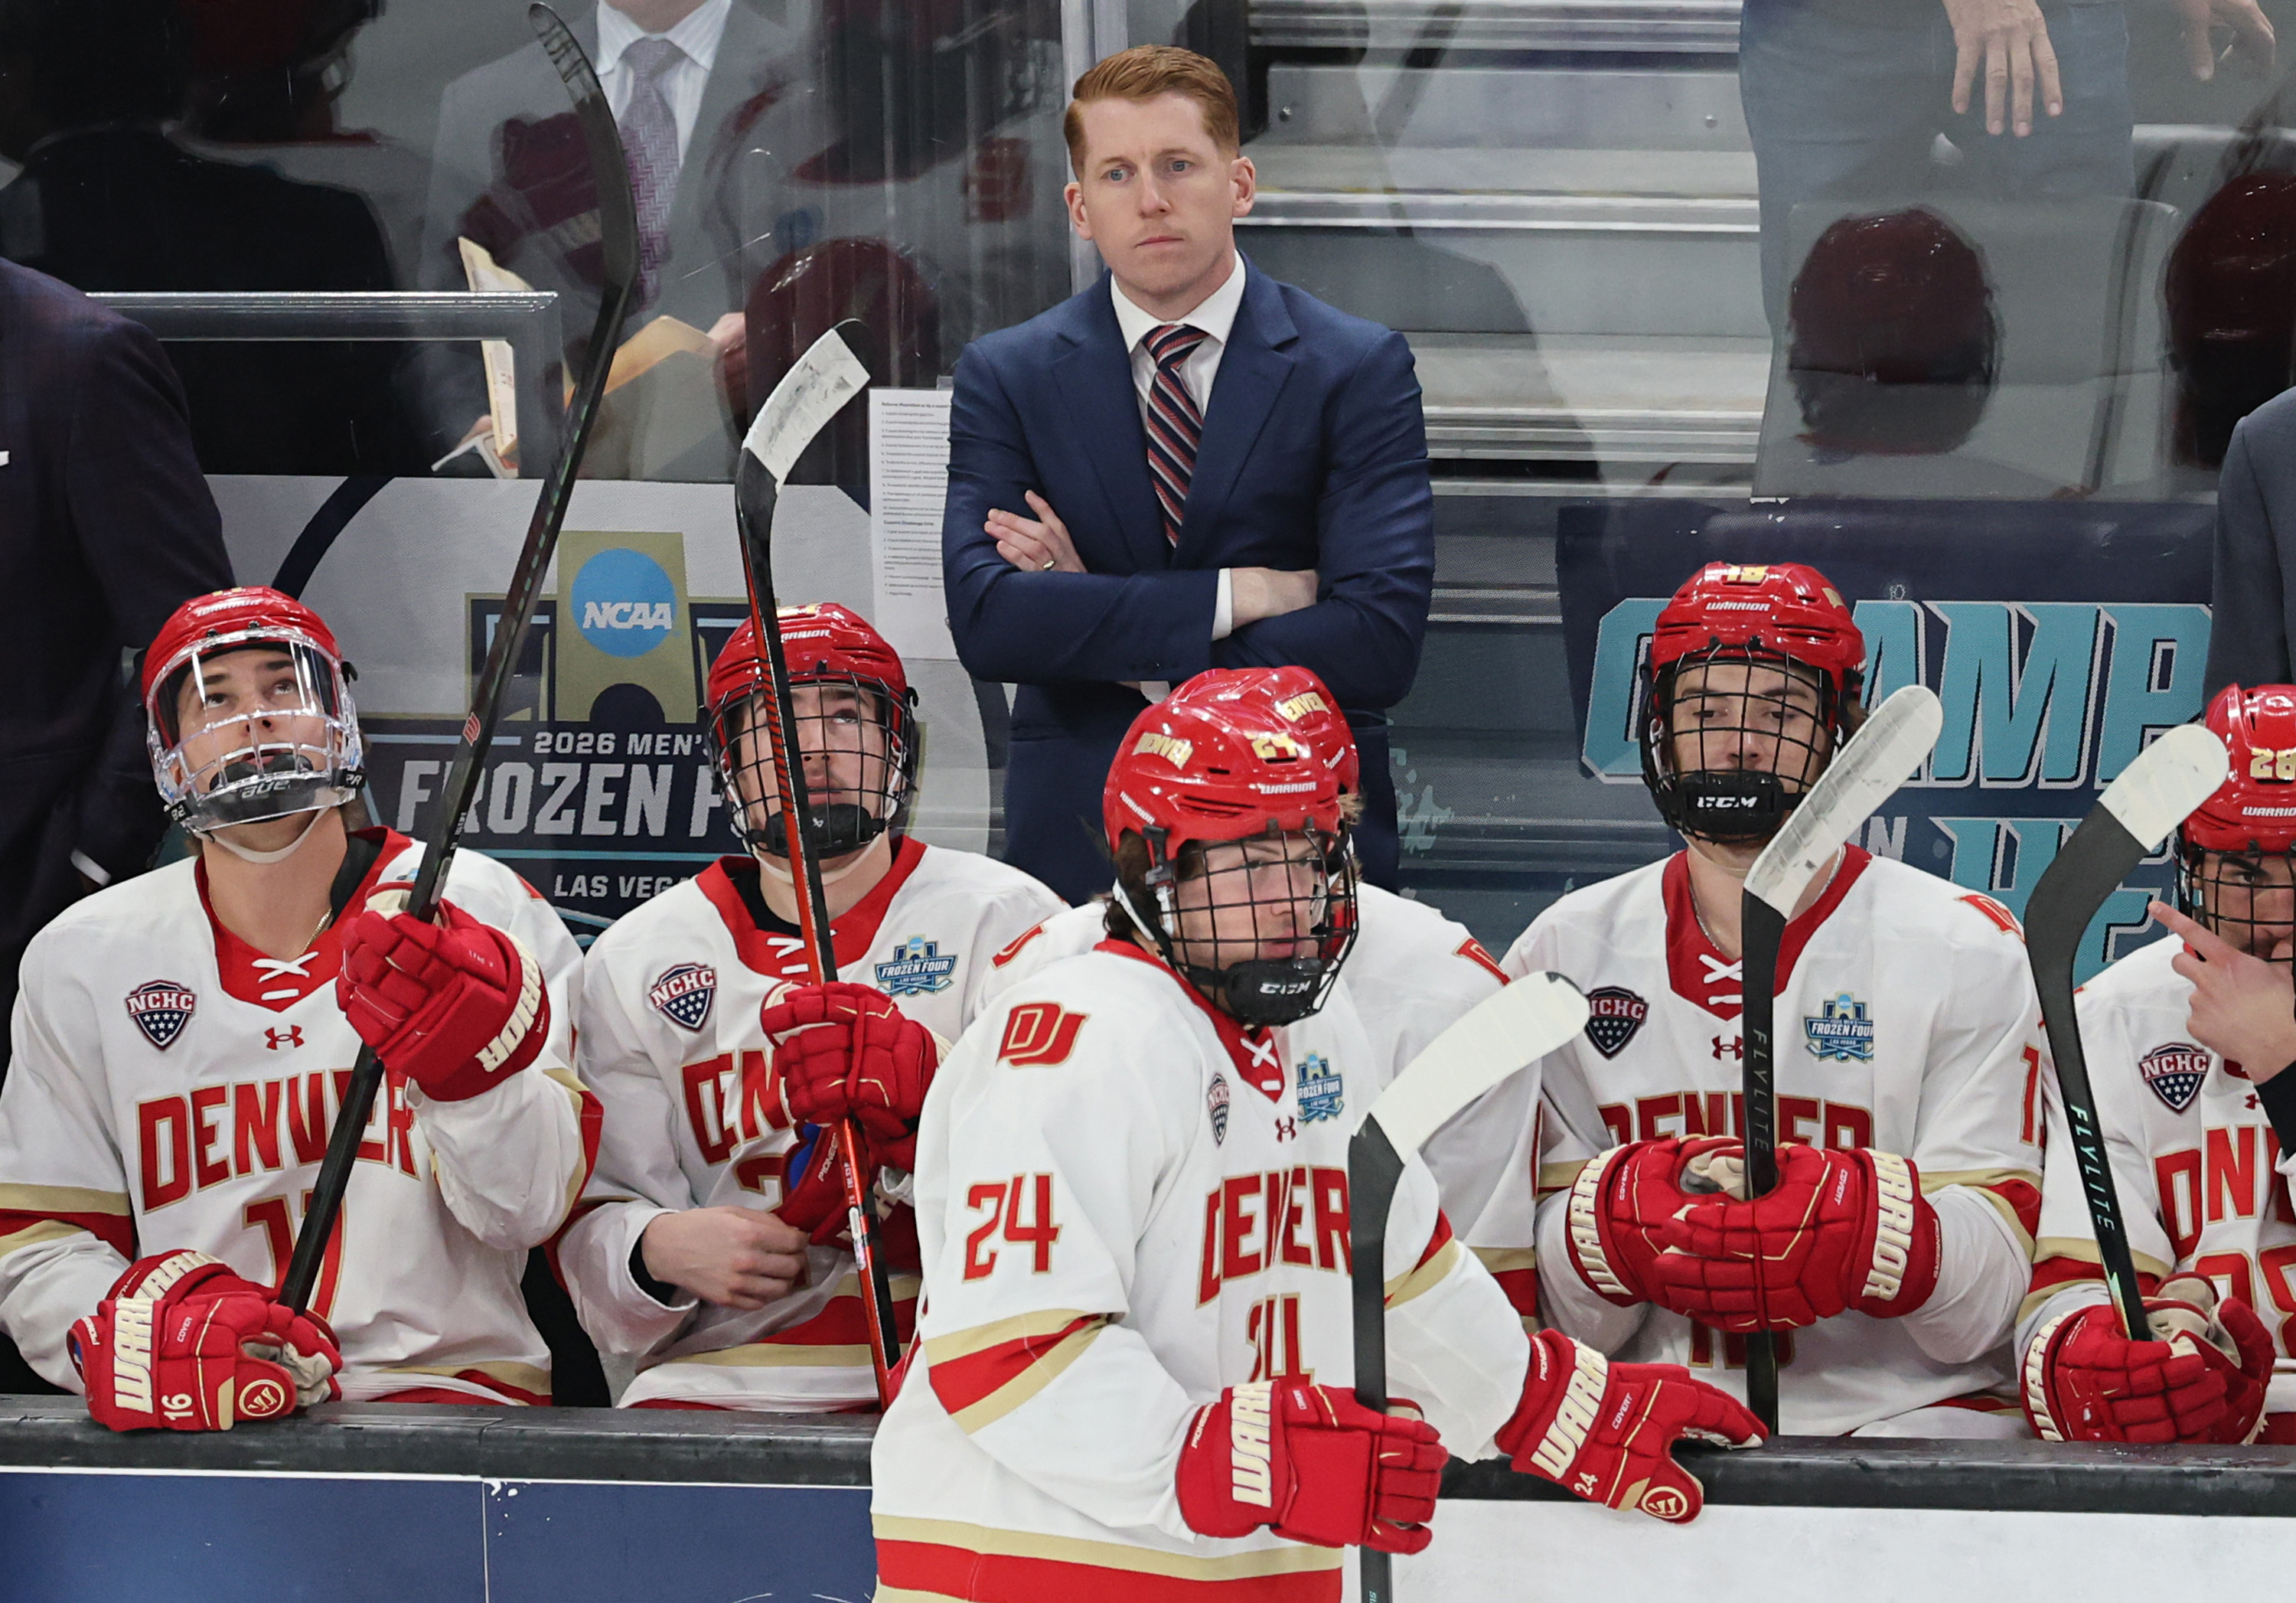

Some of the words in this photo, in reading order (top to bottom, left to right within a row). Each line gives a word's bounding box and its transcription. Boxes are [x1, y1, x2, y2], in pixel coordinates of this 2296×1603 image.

[582, 601, 673, 630] NCAA
[1705, 602, 1771, 612] WARRIOR
[780, 629, 831, 642] ARRIOR
[533, 731, 615, 754] 2026
[626, 733, 709, 756] MEN'
[2250, 747, 2296, 781] 28
[1260, 781, 1318, 795] WARRIOR
[1697, 796, 1758, 808] CCM
[2242, 806, 2296, 818] WARRIO
[554, 873, 608, 898] LAS
[618, 876, 690, 898] VEG
[881, 964, 921, 978] FROZEN
[921, 960, 950, 973] FOUR
[653, 969, 716, 1004] NCHC
[1260, 980, 1312, 994] CCM
[128, 992, 194, 1014] NCHC
[1812, 1023, 1851, 1036] FROZEN
[2142, 1054, 2209, 1080] NCHC
[1753, 1028, 1770, 1153] FLYLITE
[2069, 1102, 2115, 1232] FLYLITE
[1619, 1164, 1630, 1201] COVERT
[1834, 1168, 1848, 1206] COVERT
[961, 1172, 1063, 1285] 24
[161, 1392, 194, 1422] 16
[1611, 1392, 1633, 1431] COVERT
[1574, 1471, 1599, 1497] 24
